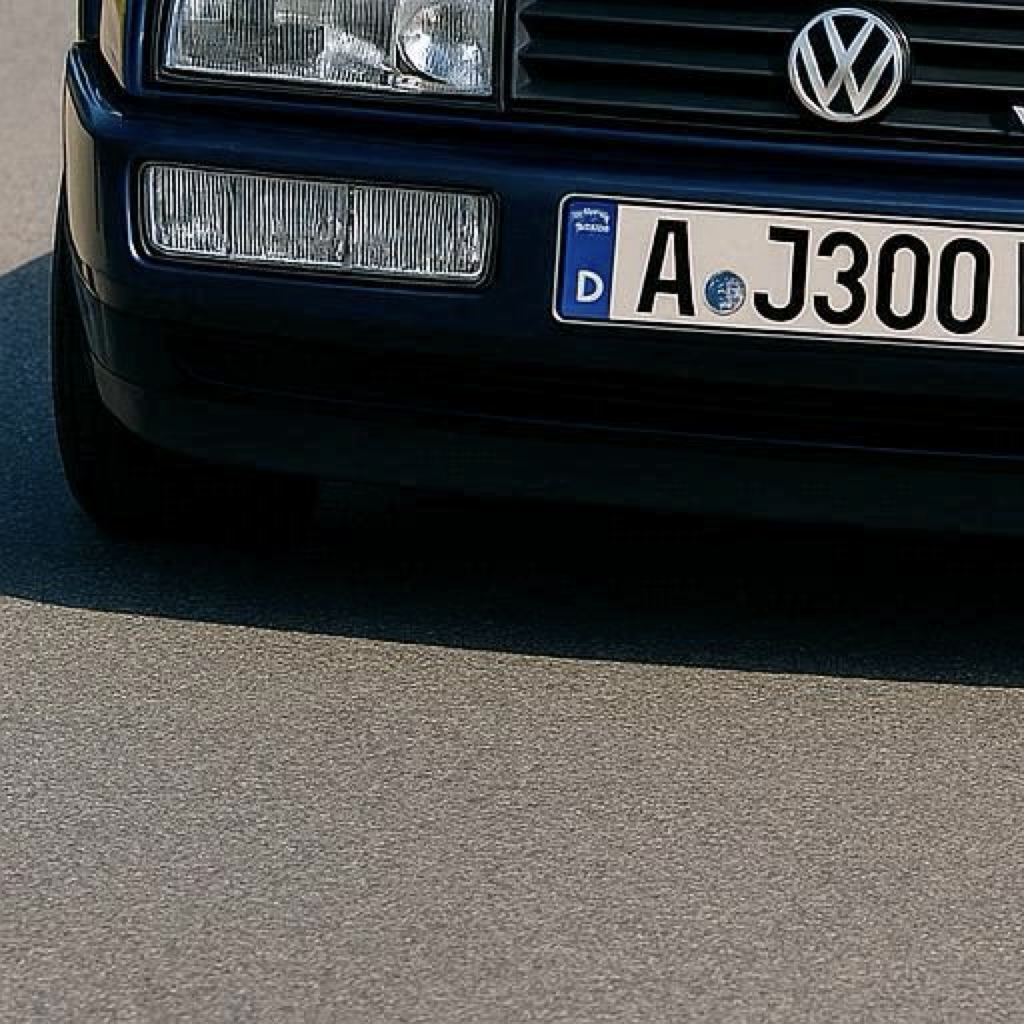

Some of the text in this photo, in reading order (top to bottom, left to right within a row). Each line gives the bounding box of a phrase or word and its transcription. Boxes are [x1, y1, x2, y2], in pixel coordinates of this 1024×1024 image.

[796, 11, 900, 117] VW
[576, 269, 604, 302] D
[636, 219, 696, 317] A
[753, 225, 991, 335] J300
